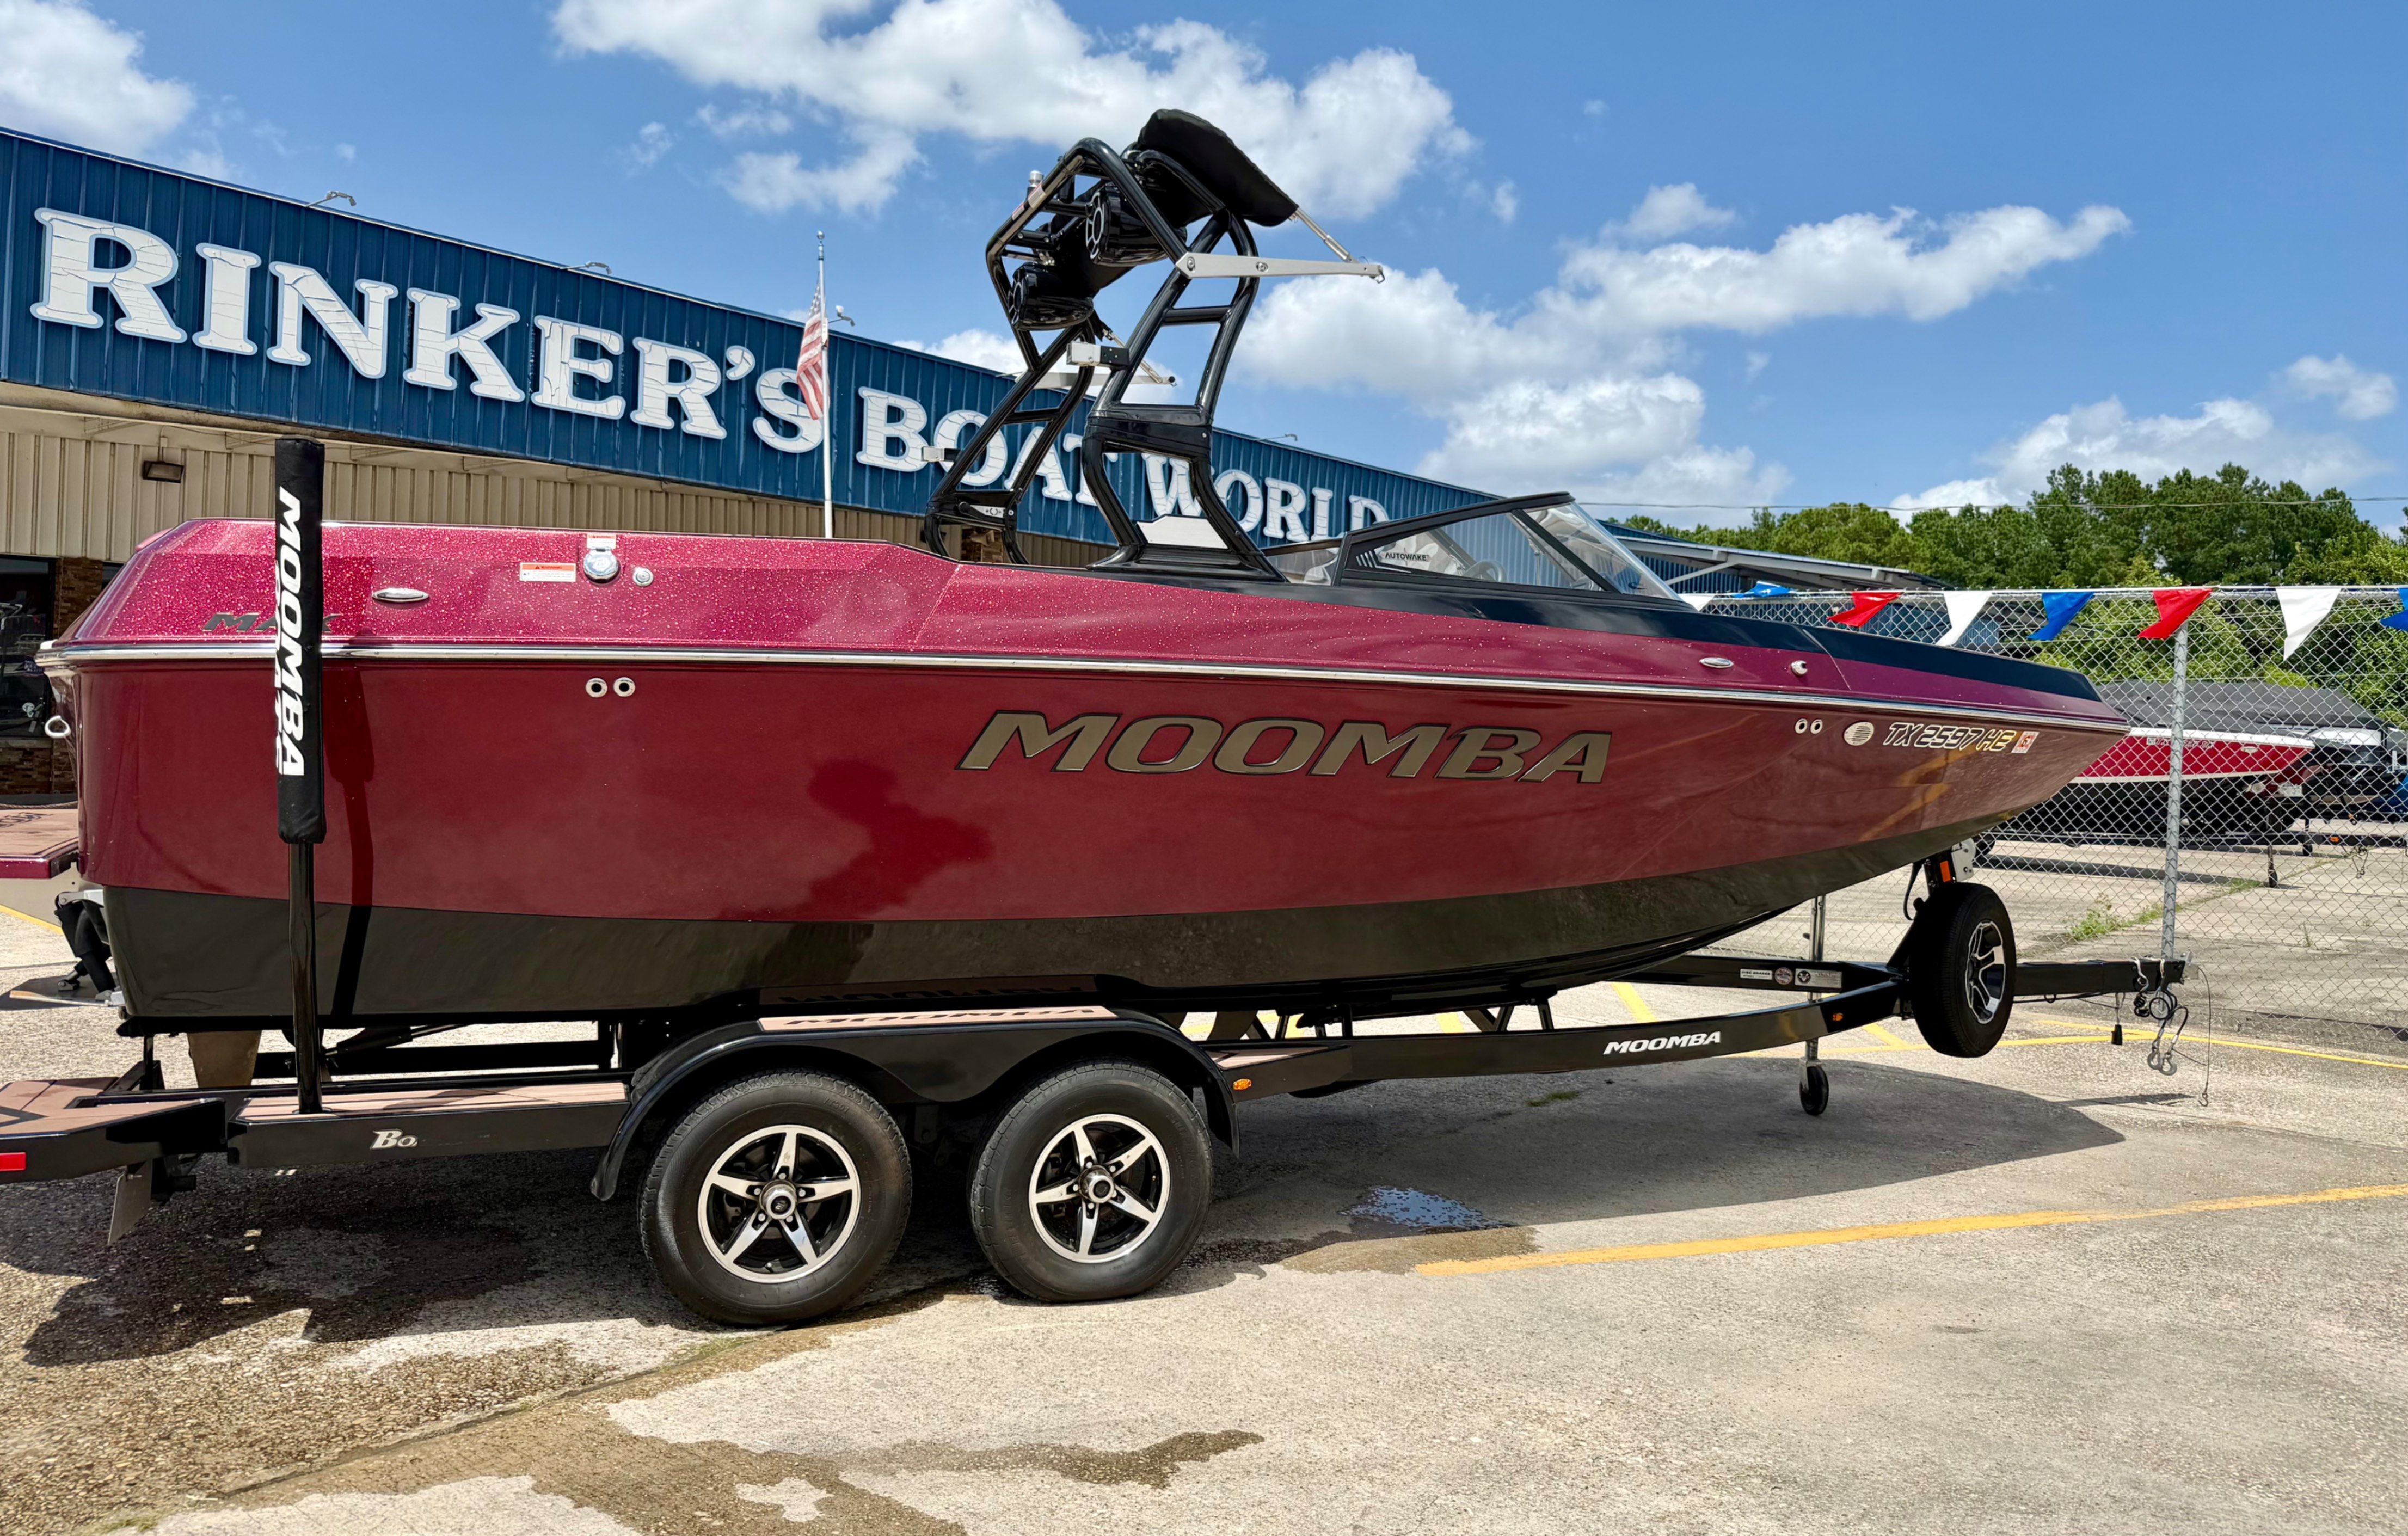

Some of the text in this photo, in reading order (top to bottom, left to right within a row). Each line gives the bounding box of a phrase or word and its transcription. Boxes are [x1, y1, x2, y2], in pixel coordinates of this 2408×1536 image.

[30, 207, 824, 453] RINKER'S
[1385, 552, 1427, 562] AUTOWAKE
[280, 486, 304, 776] MOOMBA
[955, 710, 1613, 784] MOOMBA
[1883, 722, 2017, 752] TX 2597 HE
[1603, 1031, 1721, 1055] MOOMBA
